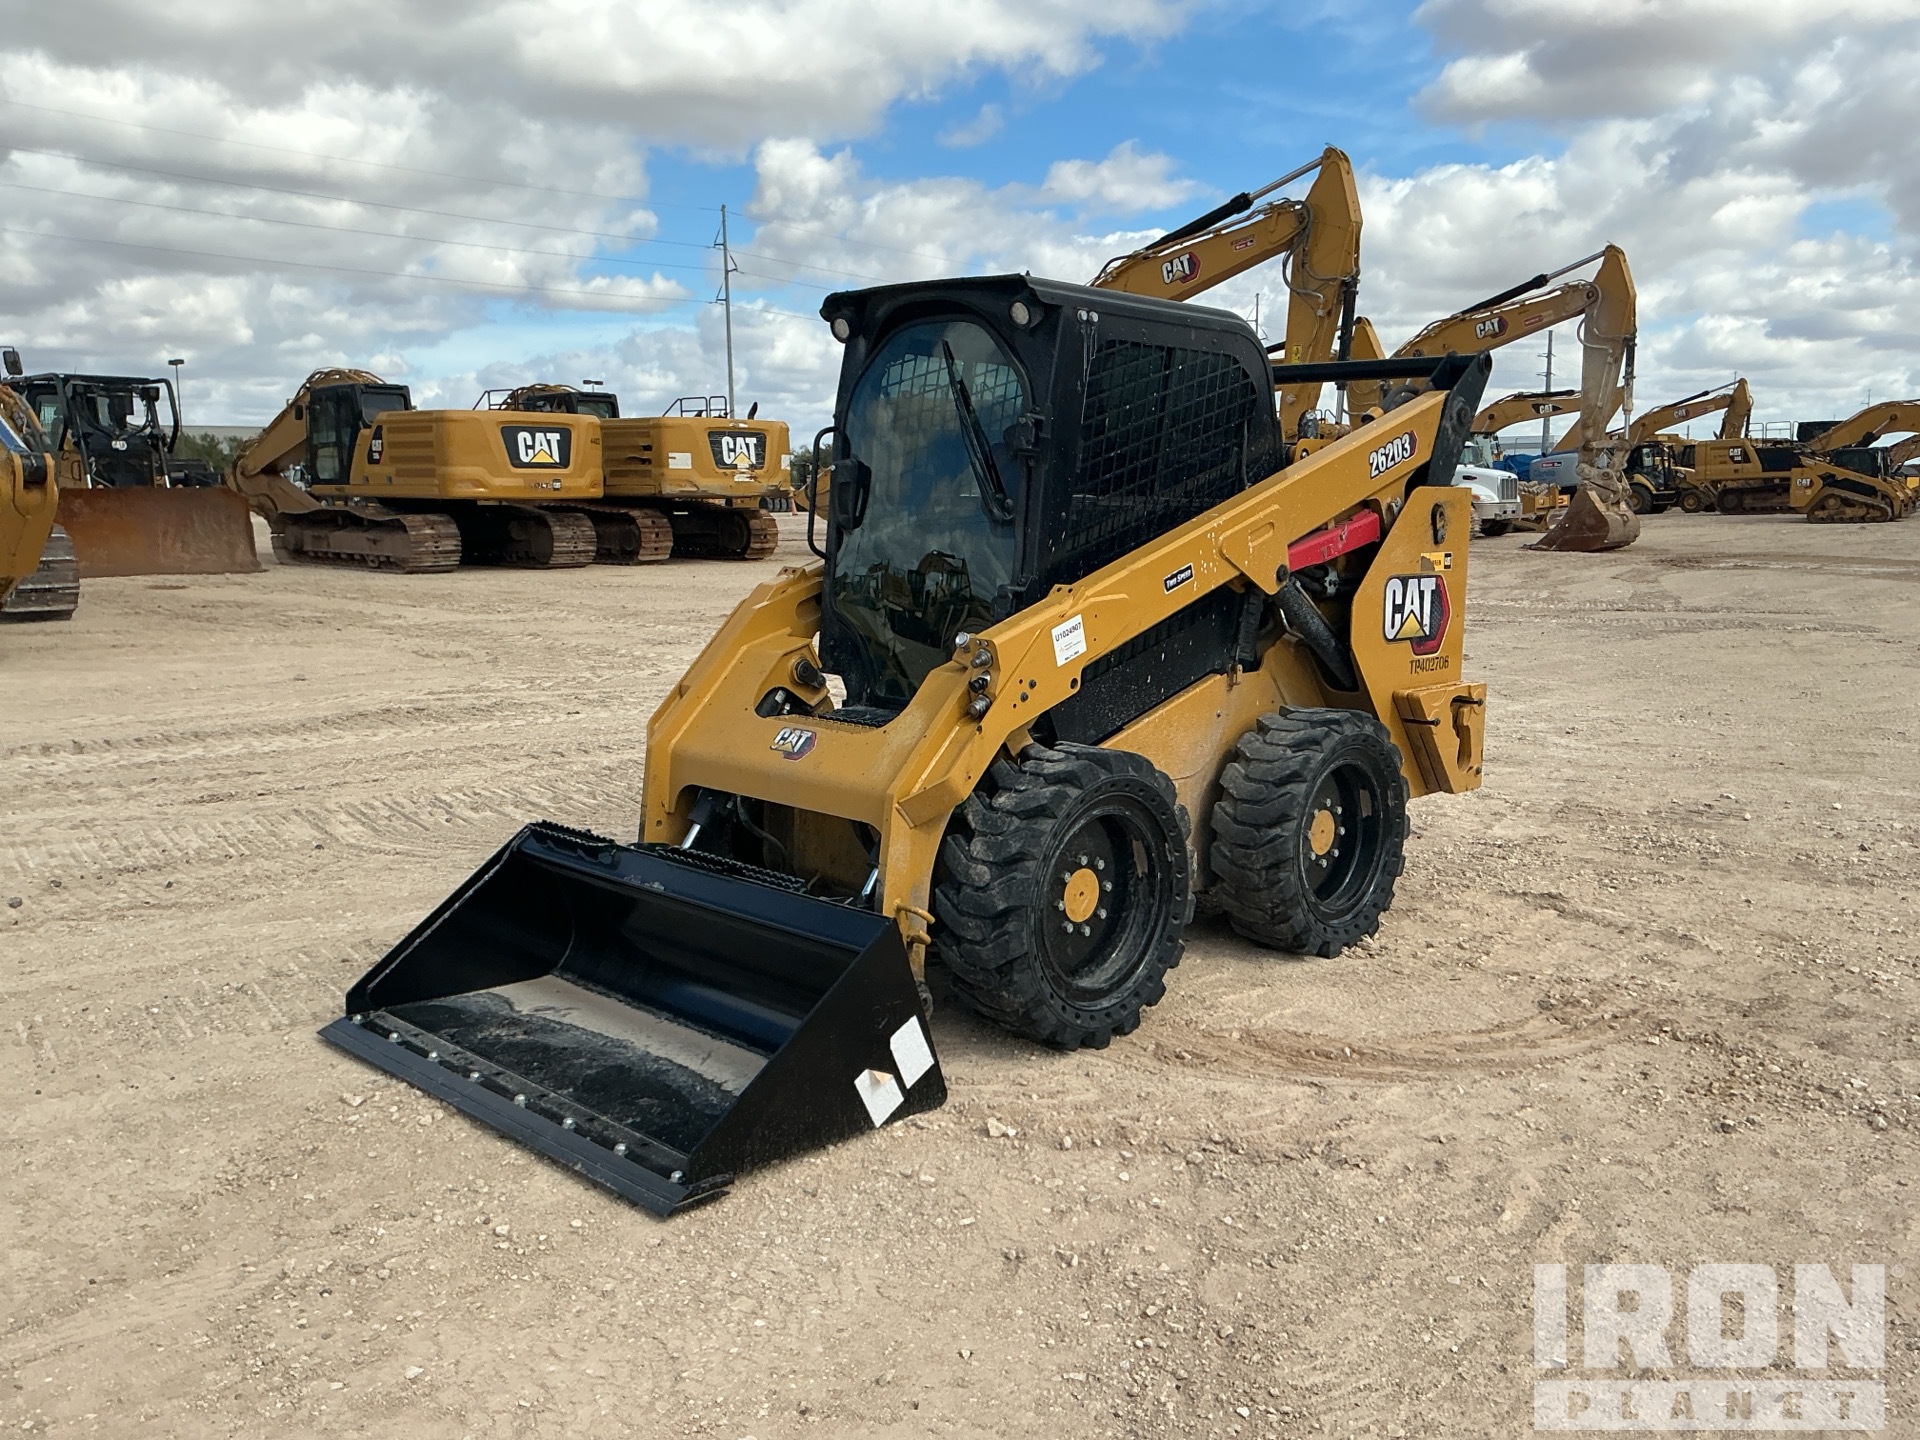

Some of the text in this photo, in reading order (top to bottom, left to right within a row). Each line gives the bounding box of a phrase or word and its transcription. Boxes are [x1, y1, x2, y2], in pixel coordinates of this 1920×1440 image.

[1162, 254, 1190, 284] CAT
[1476, 318, 1500, 339] CAT
[1674, 409, 1687, 419] CAT
[517, 431, 561, 463] CAT
[721, 436, 757, 465] CAT
[1369, 433, 1411, 478] 262D3
[1729, 448, 1742, 456] CAT
[1796, 479, 1811, 487] CAT
[1384, 578, 1436, 640] CAT
[771, 728, 813, 753] CAT
